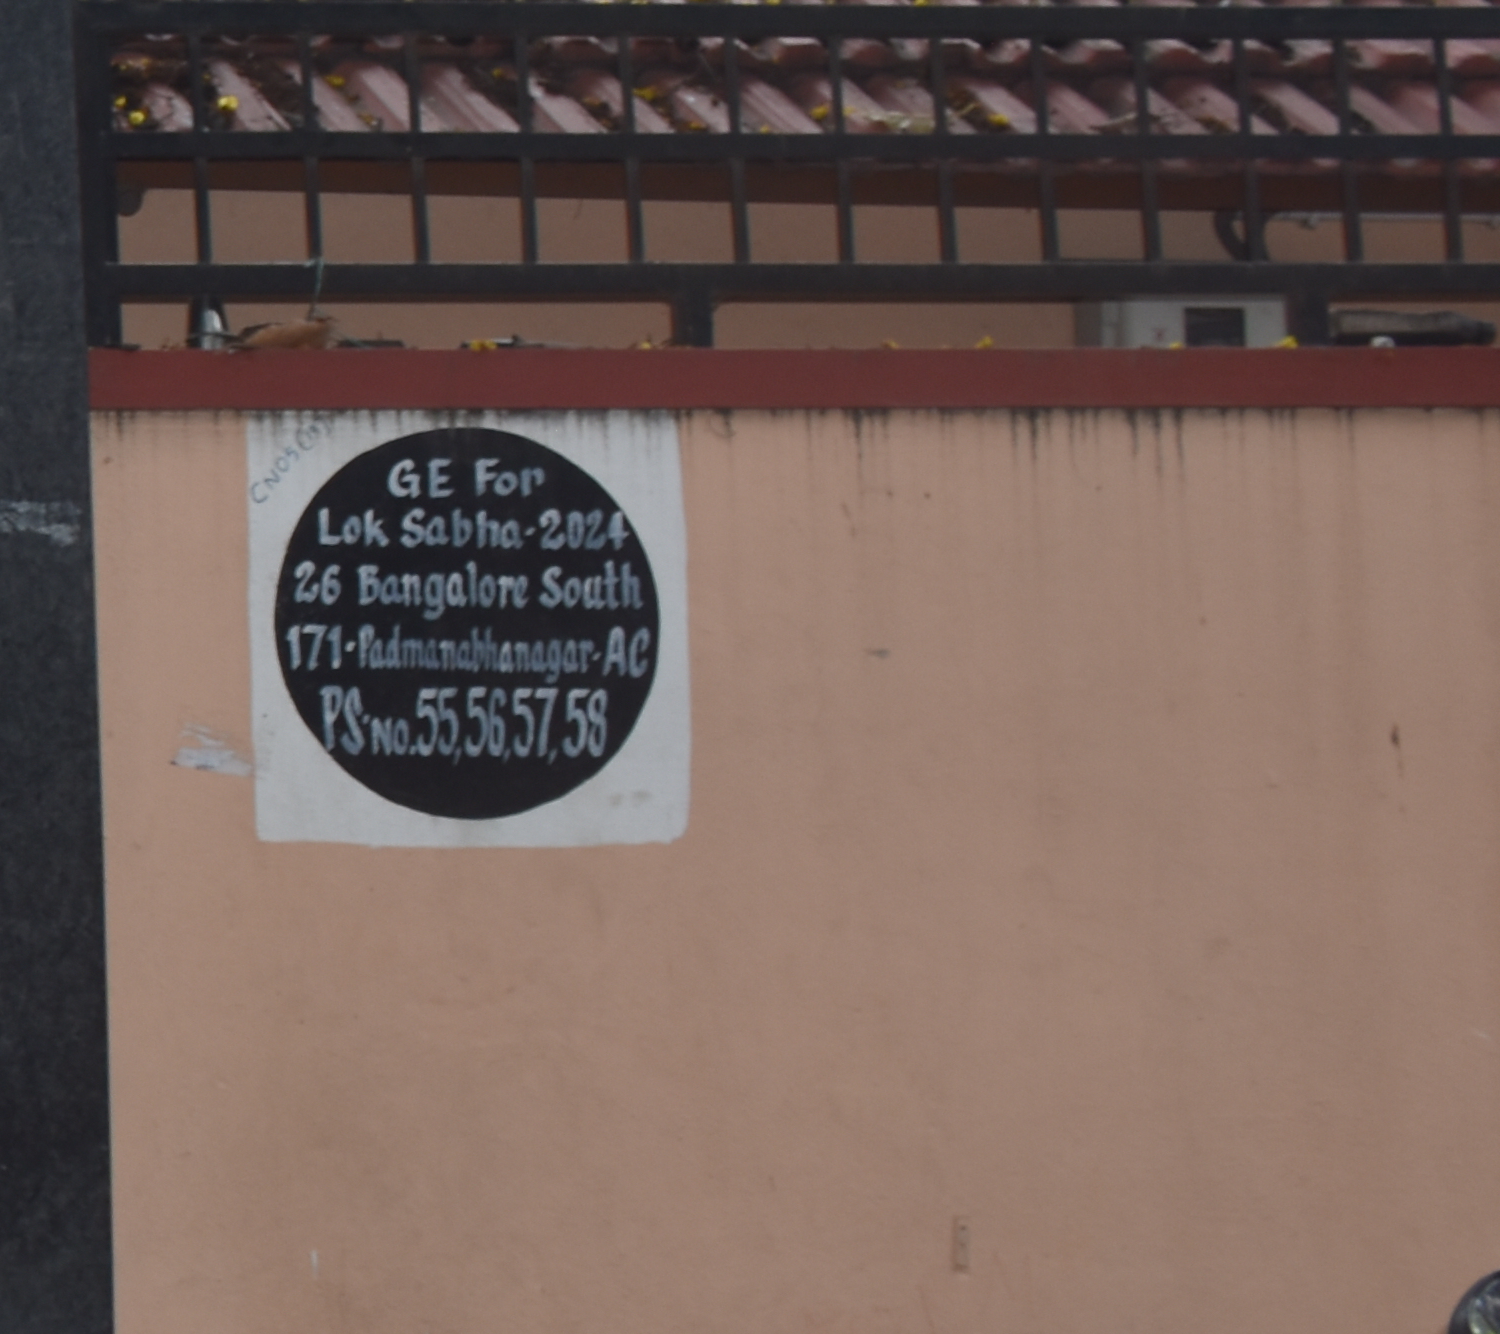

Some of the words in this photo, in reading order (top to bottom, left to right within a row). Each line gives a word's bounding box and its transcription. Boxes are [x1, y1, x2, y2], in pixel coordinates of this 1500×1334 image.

[387, 458, 454, 499] GE
[475, 458, 546, 498] For
[317, 507, 391, 548] Lok
[399, 507, 631, 551] Sabha-2024
[293, 560, 343, 606] 26
[356, 560, 529, 621] Bangalore
[538, 559, 644, 610] South
